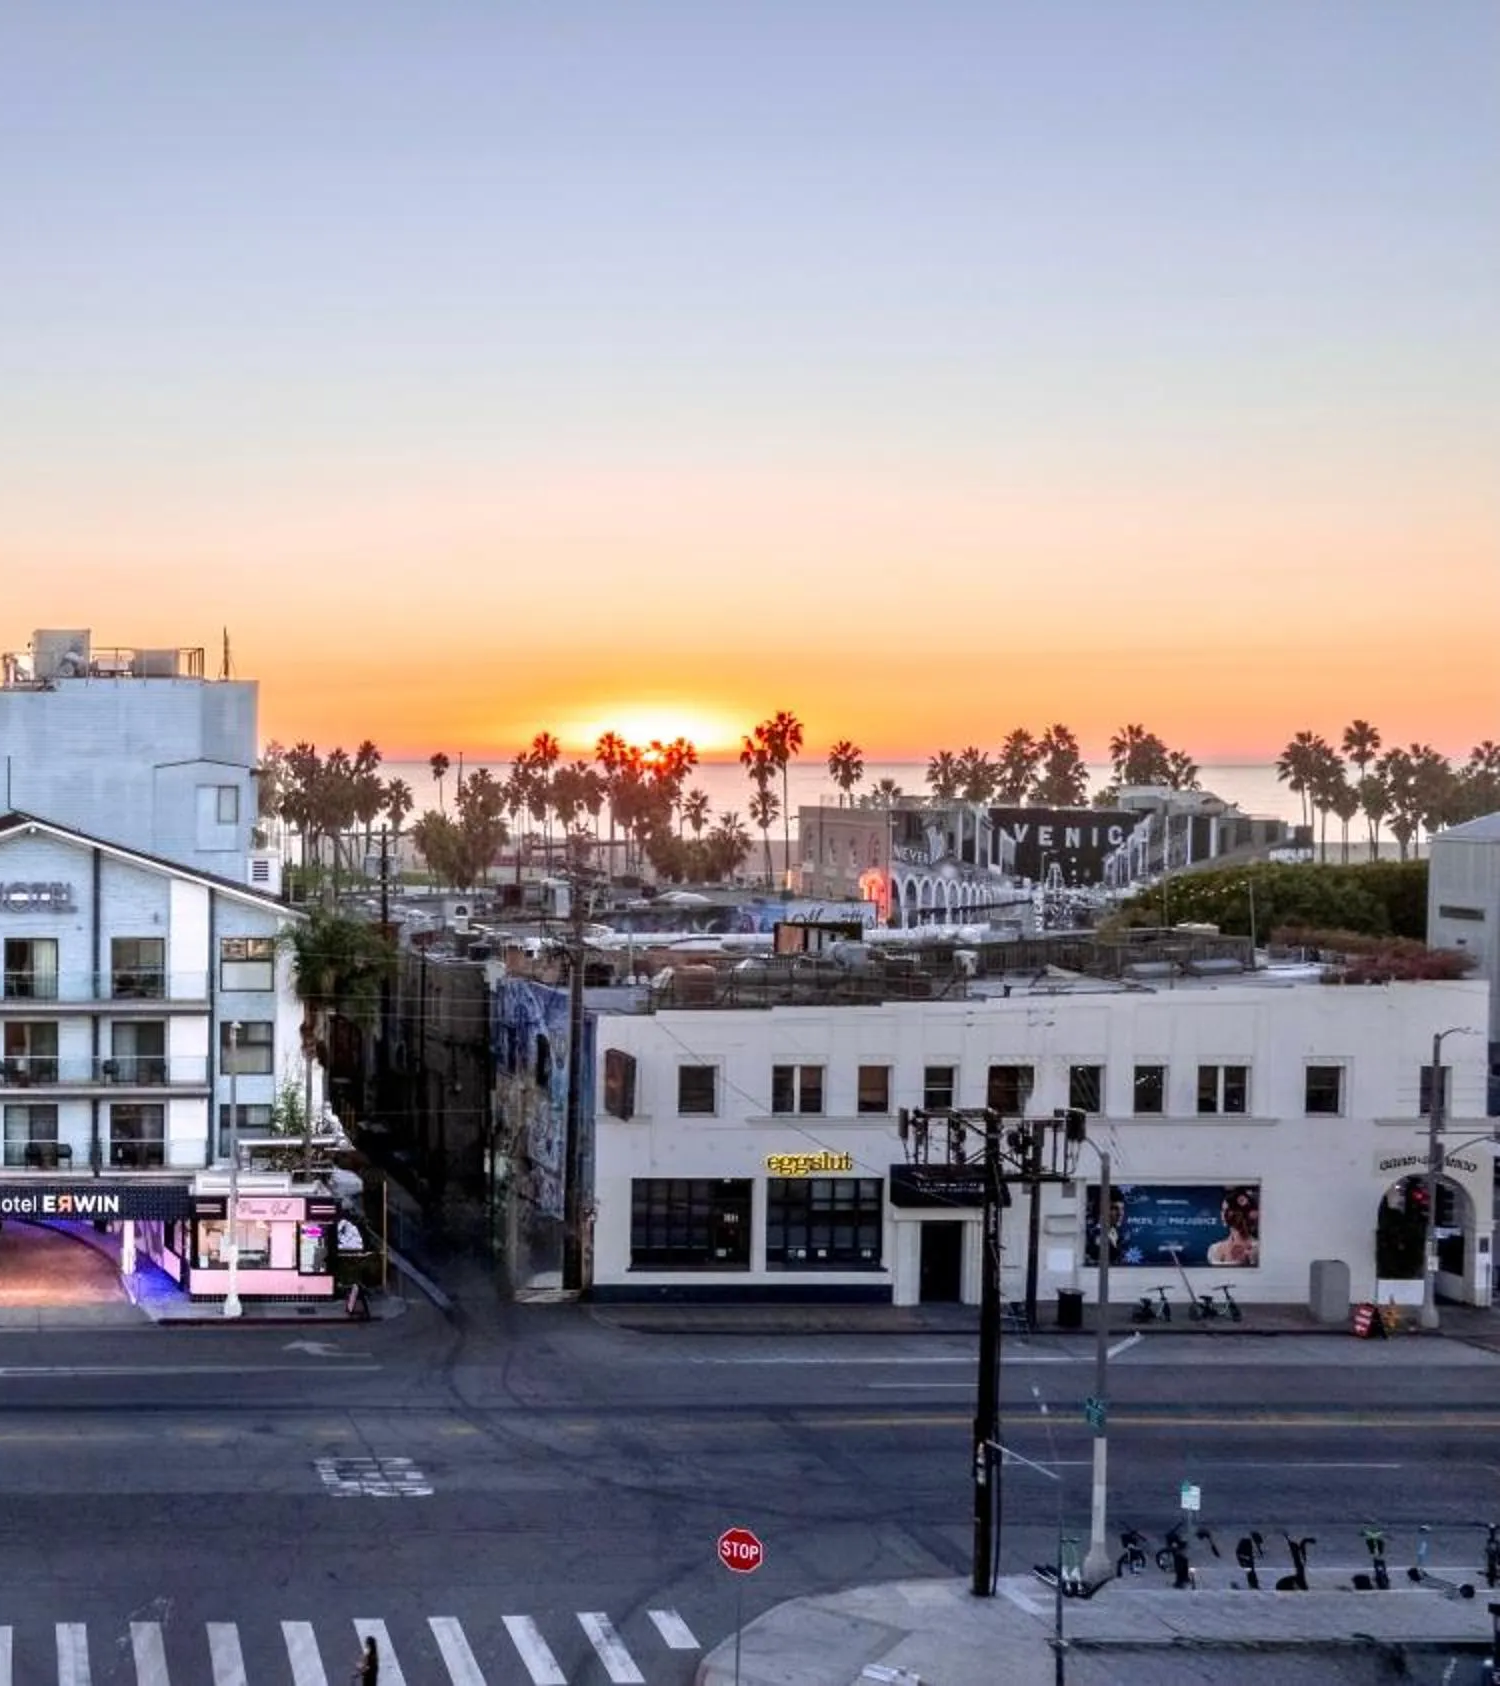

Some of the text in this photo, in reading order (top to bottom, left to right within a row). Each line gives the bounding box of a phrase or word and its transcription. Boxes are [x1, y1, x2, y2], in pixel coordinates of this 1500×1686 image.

[1013, 823, 1148, 848] VENIC
[766, 1151, 853, 1176] eggslut
[721, 1540, 759, 1561] STOP
